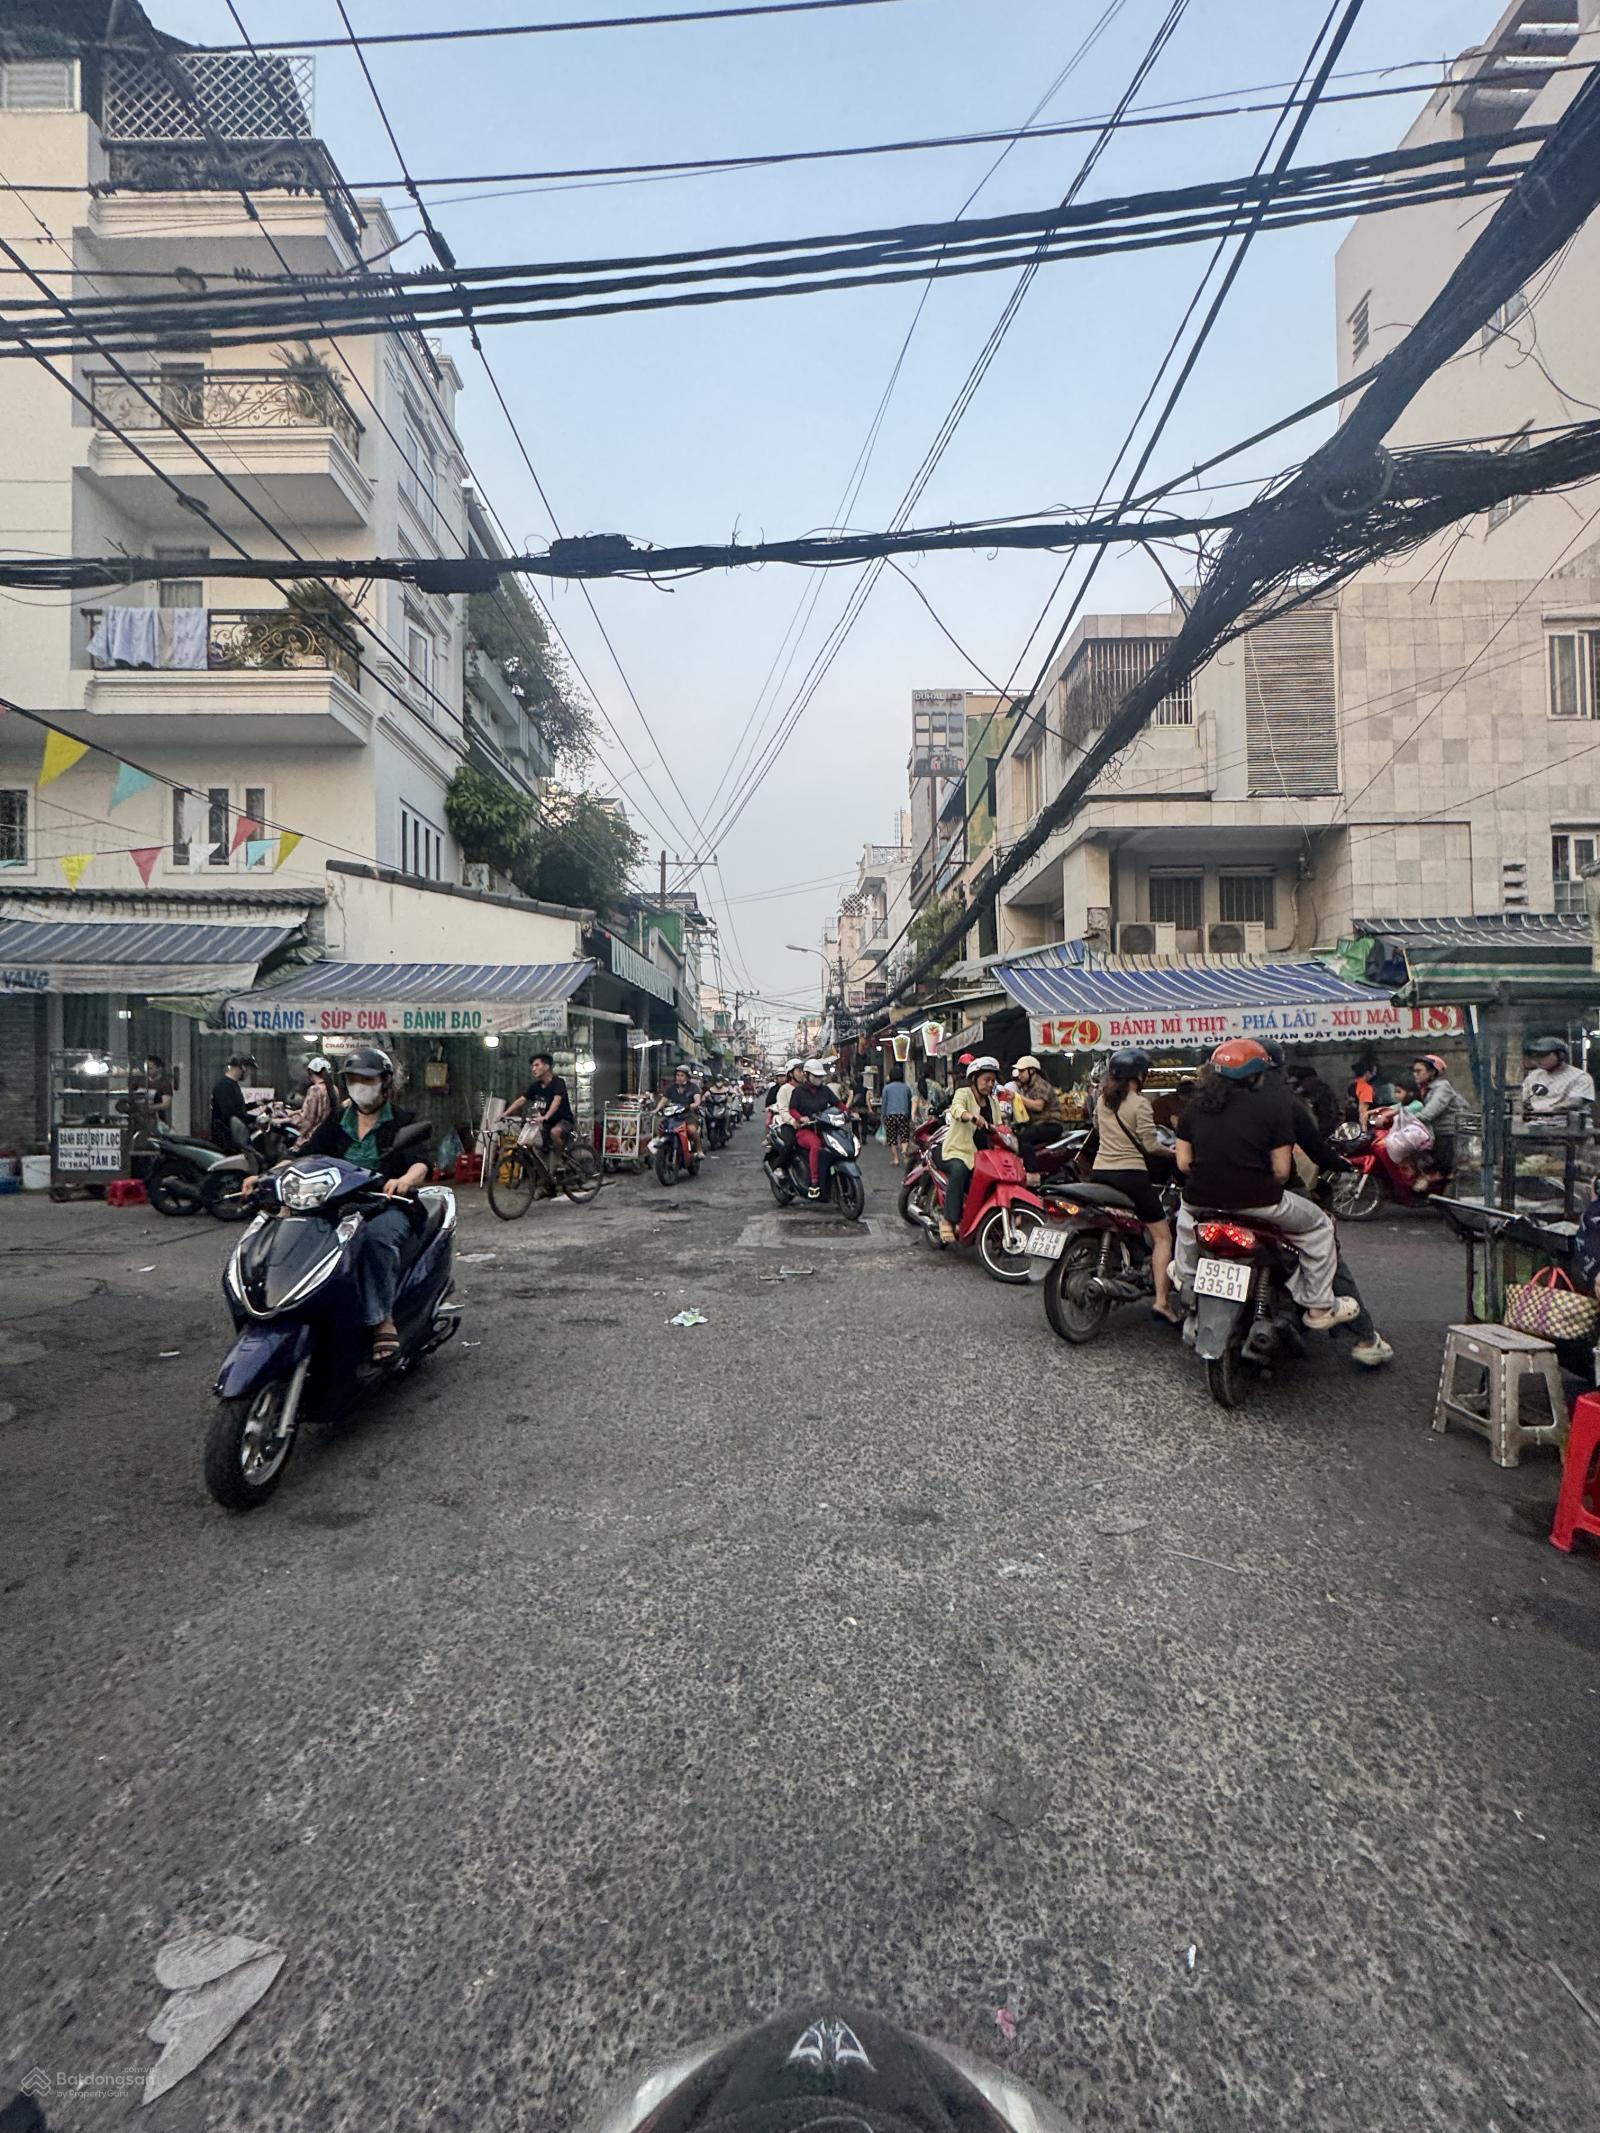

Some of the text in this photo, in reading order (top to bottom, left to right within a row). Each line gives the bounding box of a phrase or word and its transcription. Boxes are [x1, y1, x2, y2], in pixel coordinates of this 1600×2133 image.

[320, 1007, 351, 1030] SÚP
[357, 1011, 387, 1030] CUA
[403, 1007, 446, 1030] BÁNH
[451, 1011, 482, 1029] BAO
[1039, 1019, 1102, 1048] 179
[1110, 1016, 1156, 1036] BÁNH
[1161, 1013, 1182, 1034] MÌ
[1187, 1016, 1227, 1035] THỊT
[1242, 1010, 1279, 1030] PHÁ
[1331, 1006, 1362, 1027] XÍU
[1367, 1008, 1400, 1028] MẠI
[1110, 1039, 1131, 1047] CÓ
[1136, 1038, 1175, 1046] BÁNH
[1180, 1036, 1198, 1044] MÌ
[1031, 1241, 1057, 1257] 9281
[1205, 1261, 1240, 1282] 59-C1
[1198, 1276, 1242, 1298] 335.81
